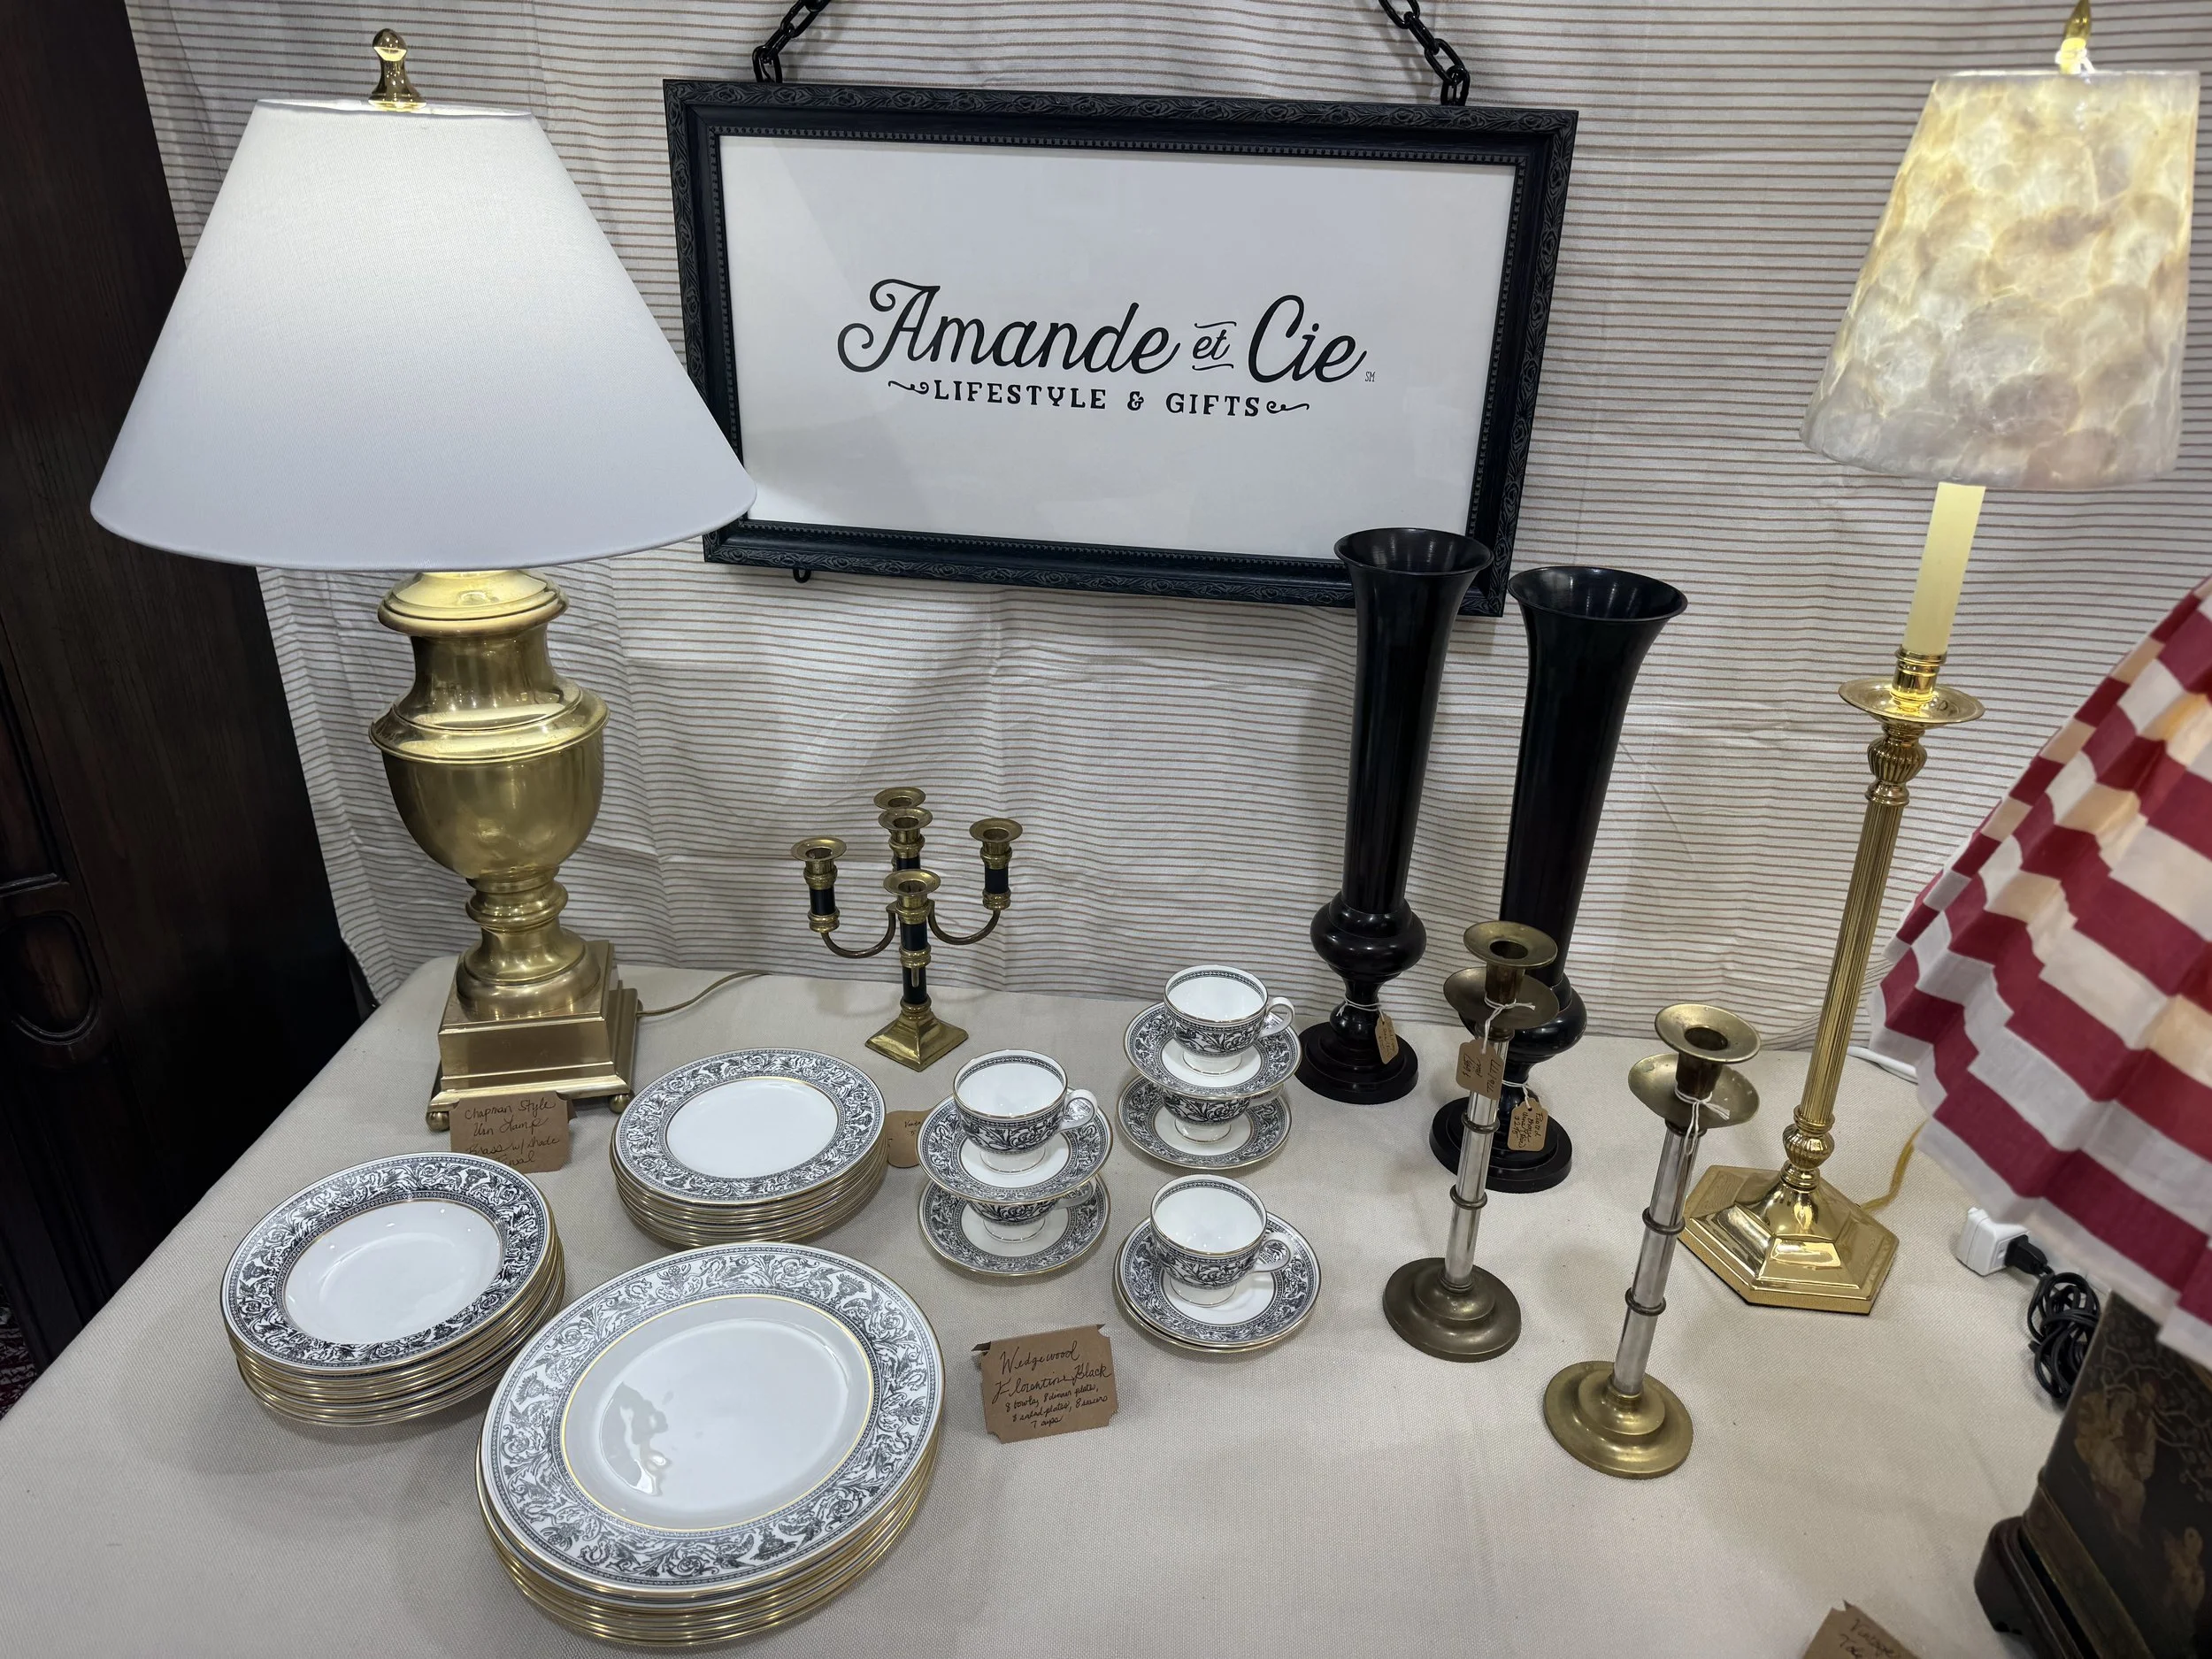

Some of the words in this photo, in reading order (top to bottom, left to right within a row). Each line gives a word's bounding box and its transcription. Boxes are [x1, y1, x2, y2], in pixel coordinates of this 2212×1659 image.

[837, 279, 1181, 374] Amande
[1192, 328, 1231, 361] et
[1248, 295, 1368, 384] Cie
[934, 380, 1107, 411] LIFESTYLE
[1127, 391, 1145, 412] &
[1165, 392, 1260, 417] GIFTS
[465, 1104, 512, 1120] Chapman
[518, 1097, 557, 1118] Style
[473, 1123, 494, 1137] Urn
[499, 1115, 549, 1136] Lamp
[1001, 1340, 1080, 1375] Wedgewood
[992, 1372, 1072, 1404] Florentine
[1072, 1363, 1112, 1386] Black
